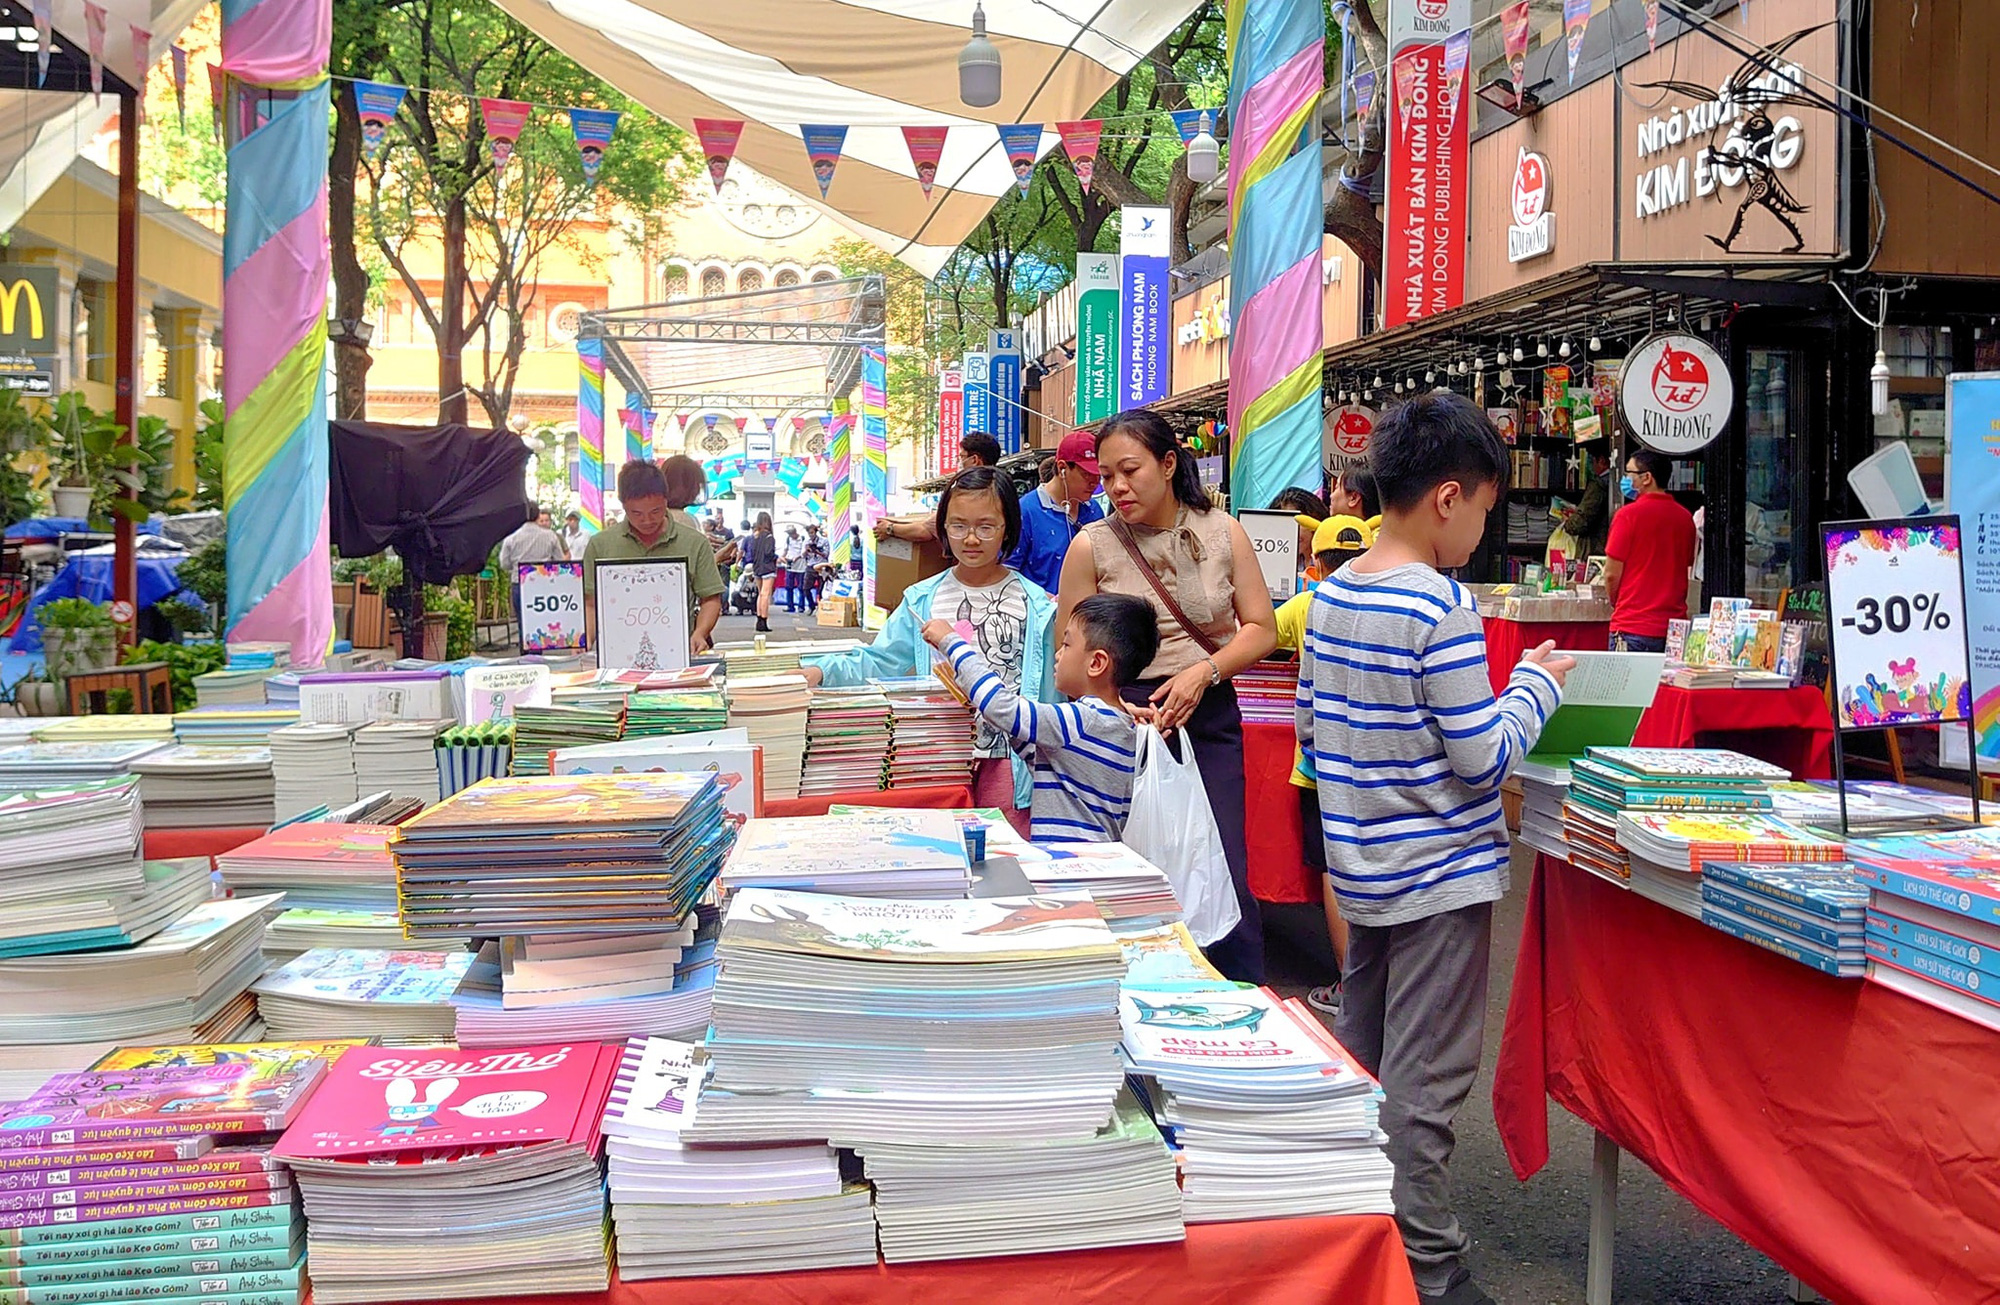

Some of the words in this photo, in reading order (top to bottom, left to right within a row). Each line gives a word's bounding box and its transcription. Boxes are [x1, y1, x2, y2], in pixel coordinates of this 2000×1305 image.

[1413, 16, 1428, 31] KIM
[1411, 124, 1427, 162] KIM
[1638, 106, 1684, 157] Nhà
[1435, 124, 1451, 222] PUBLISHING
[1636, 156, 1690, 218] KIM
[1406, 168, 1426, 208] BẢN
[1403, 213, 1425, 268] XUẤT
[1433, 226, 1449, 281] DONG
[1511, 229, 1525, 258] KIM
[1133, 272, 1145, 303] NAM
[1149, 284, 1158, 314] BOOK
[1404, 272, 1423, 317] NHÀ
[1132, 305, 1145, 361] PHƯƠNG
[1148, 317, 1157, 342] NAM
[1095, 334, 1105, 366] NAM
[1130, 363, 1144, 401] SÁCH
[1148, 345, 1157, 390] PHUONG
[1092, 369, 1105, 398] NHÃ
[966, 407, 978, 426] BẢN
[1642, 409, 1670, 437] KIM
[526, 594, 578, 613] -50%
[618, 606, 671, 626] -50%
[1842, 593, 1950, 635] -30%
[1903, 881, 1918, 895] LỊCH
[1915, 931, 1928, 945] LỊCH
[1913, 955, 1928, 969] LỊCH
[359, 1058, 482, 1077] Siêu
[478, 1047, 572, 1072] Thỏ
[144, 1125, 164, 1136] Pha
[53, 1155, 73, 1165] Pha
[140, 1166, 160, 1177] Pha
[147, 1202, 167, 1213] Pha
[56, 1232, 73, 1241] nay
[54, 1251, 71, 1260] nay
[62, 1292, 80, 1301] nay
